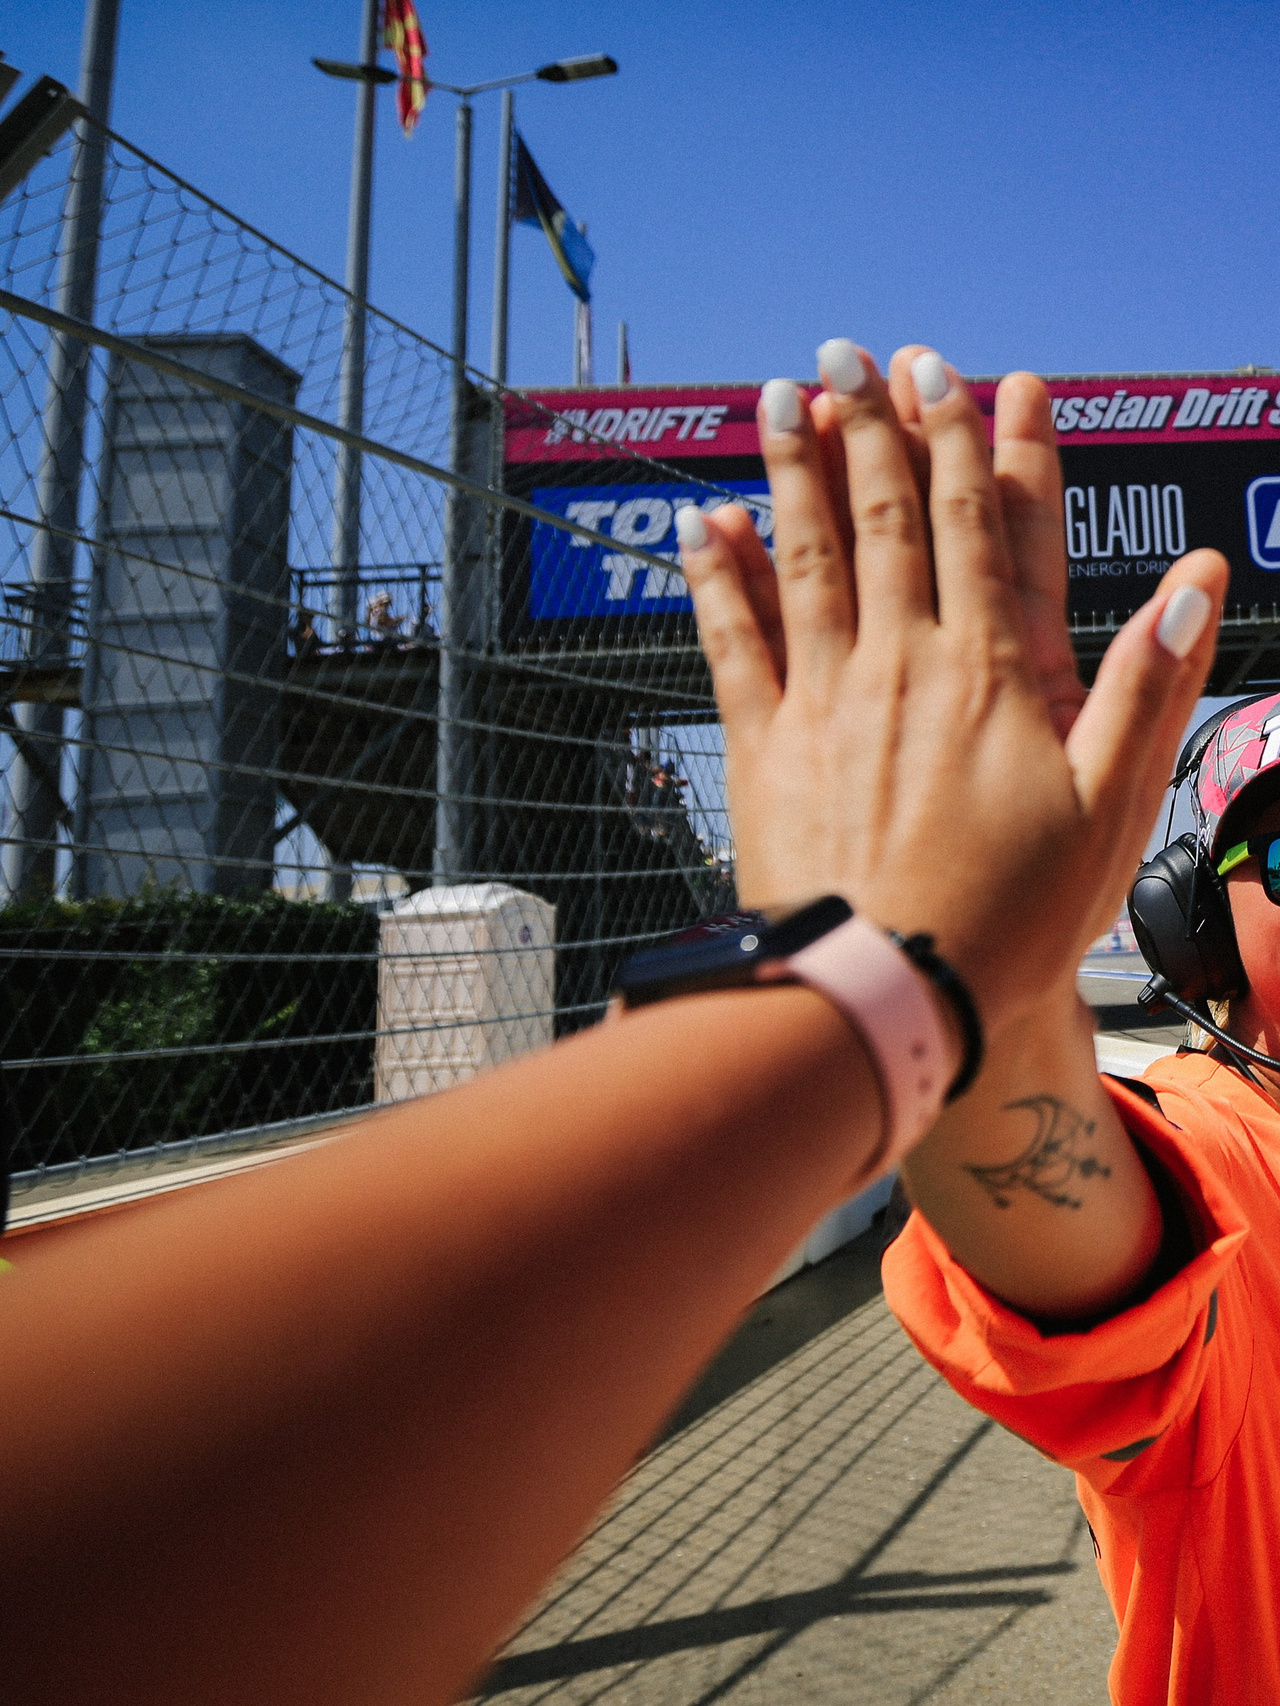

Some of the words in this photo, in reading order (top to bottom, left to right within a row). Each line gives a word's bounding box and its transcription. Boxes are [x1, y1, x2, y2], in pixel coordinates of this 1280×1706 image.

[1172, 387, 1269, 428] Drift
[1064, 484, 1187, 559] GLADIO
[1069, 562, 1131, 578] ENERGY
